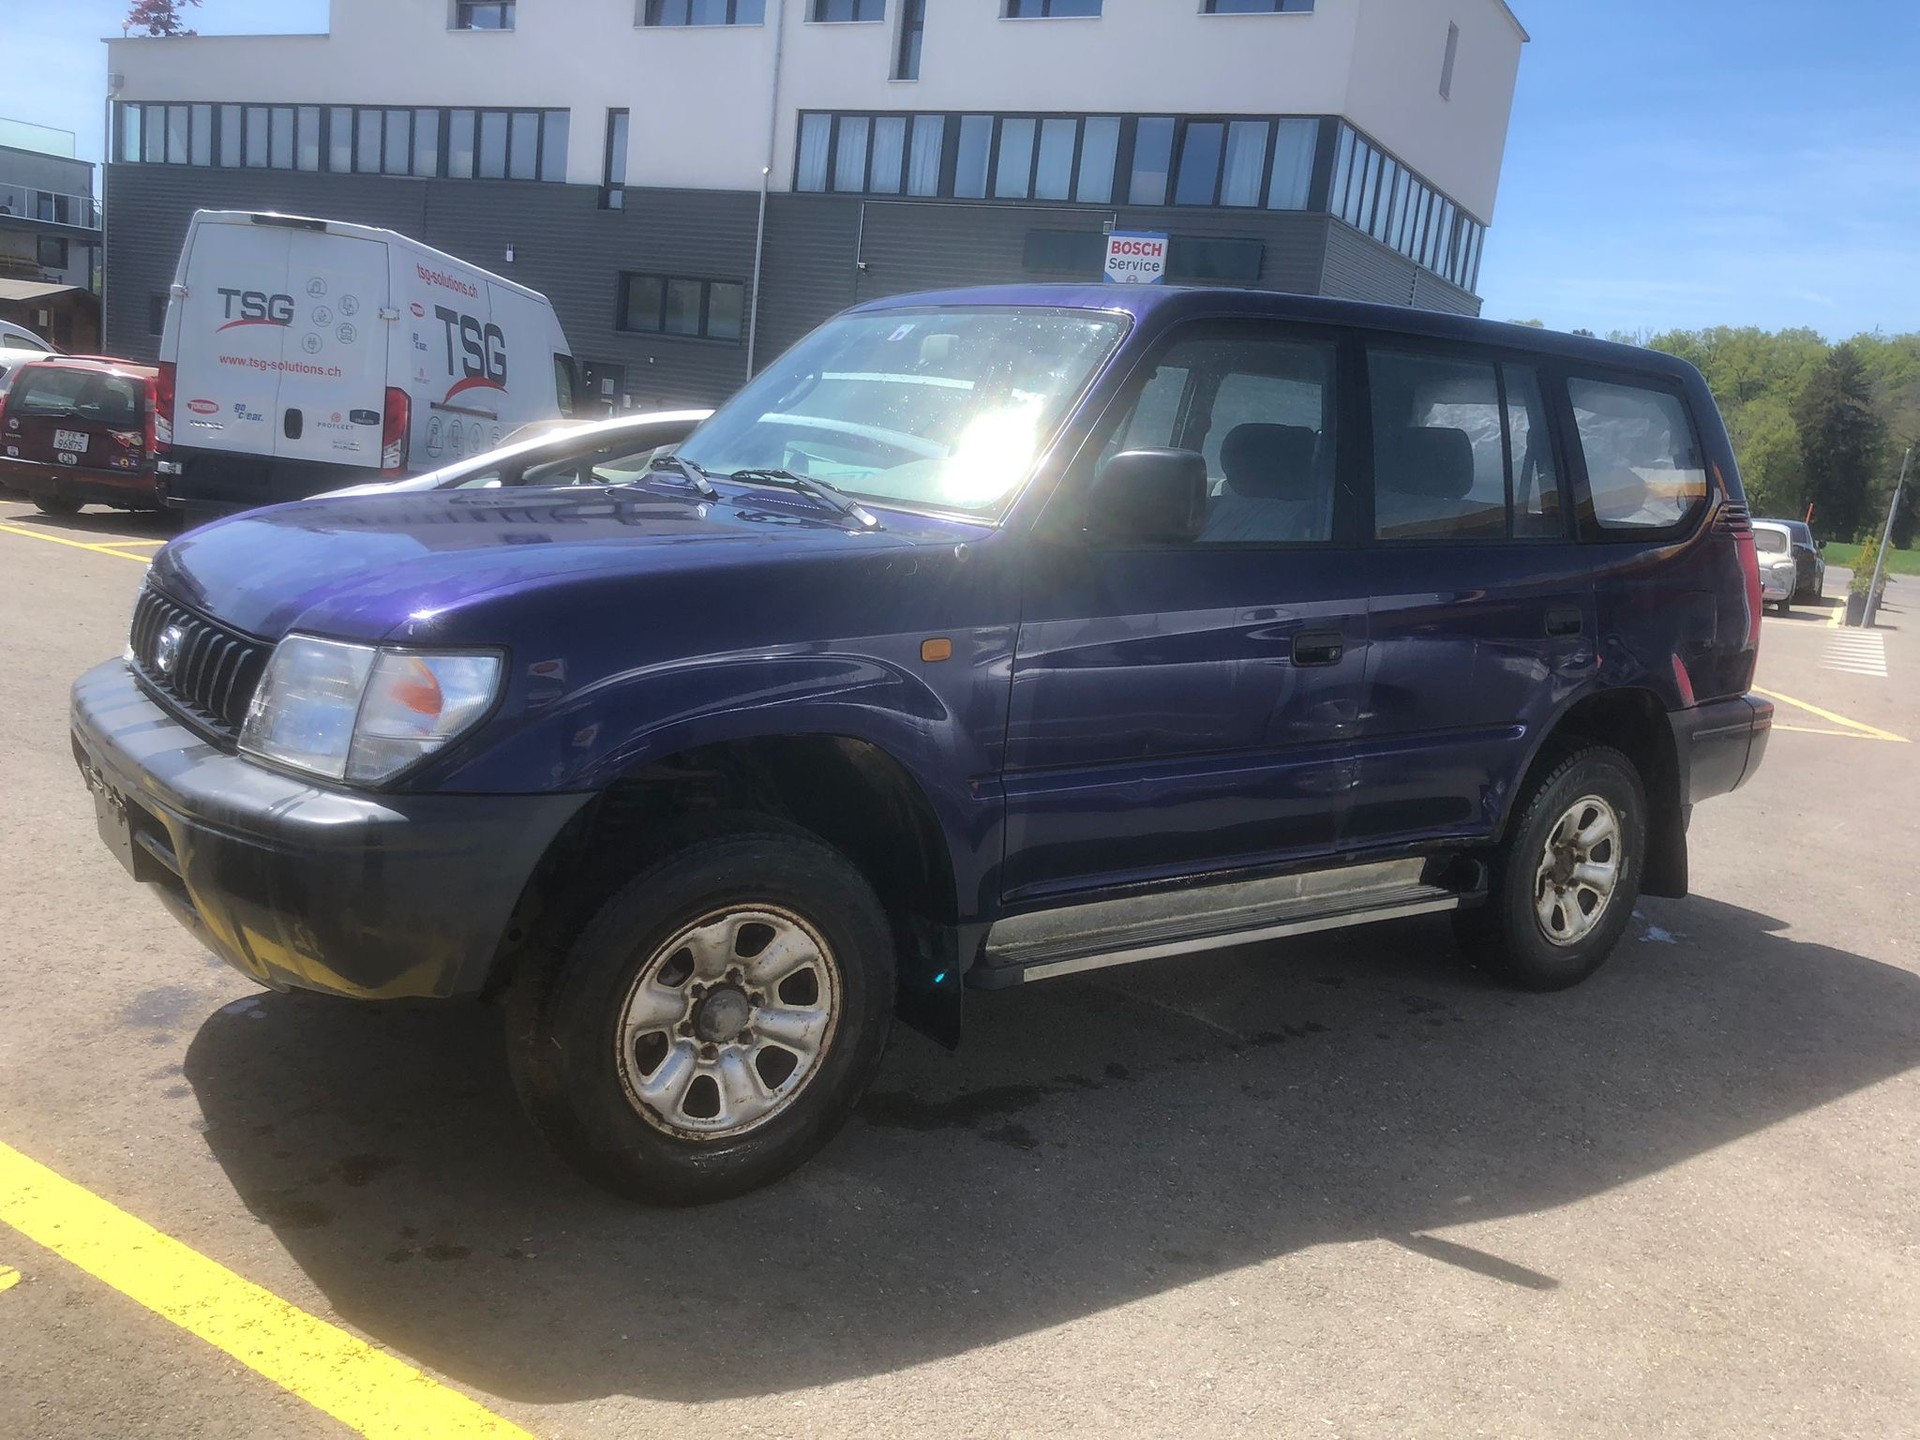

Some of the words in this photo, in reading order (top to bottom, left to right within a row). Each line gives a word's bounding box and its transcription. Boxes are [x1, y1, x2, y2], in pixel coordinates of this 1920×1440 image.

[1111, 241, 1162, 256] BOSCH
[1108, 257, 1160, 272] Service
[416, 262, 478, 299] tsg-solutions.ch
[217, 287, 295, 326] TSG
[434, 304, 507, 387] TSG
[219, 355, 342, 377] www.tsg-solutions.ch
